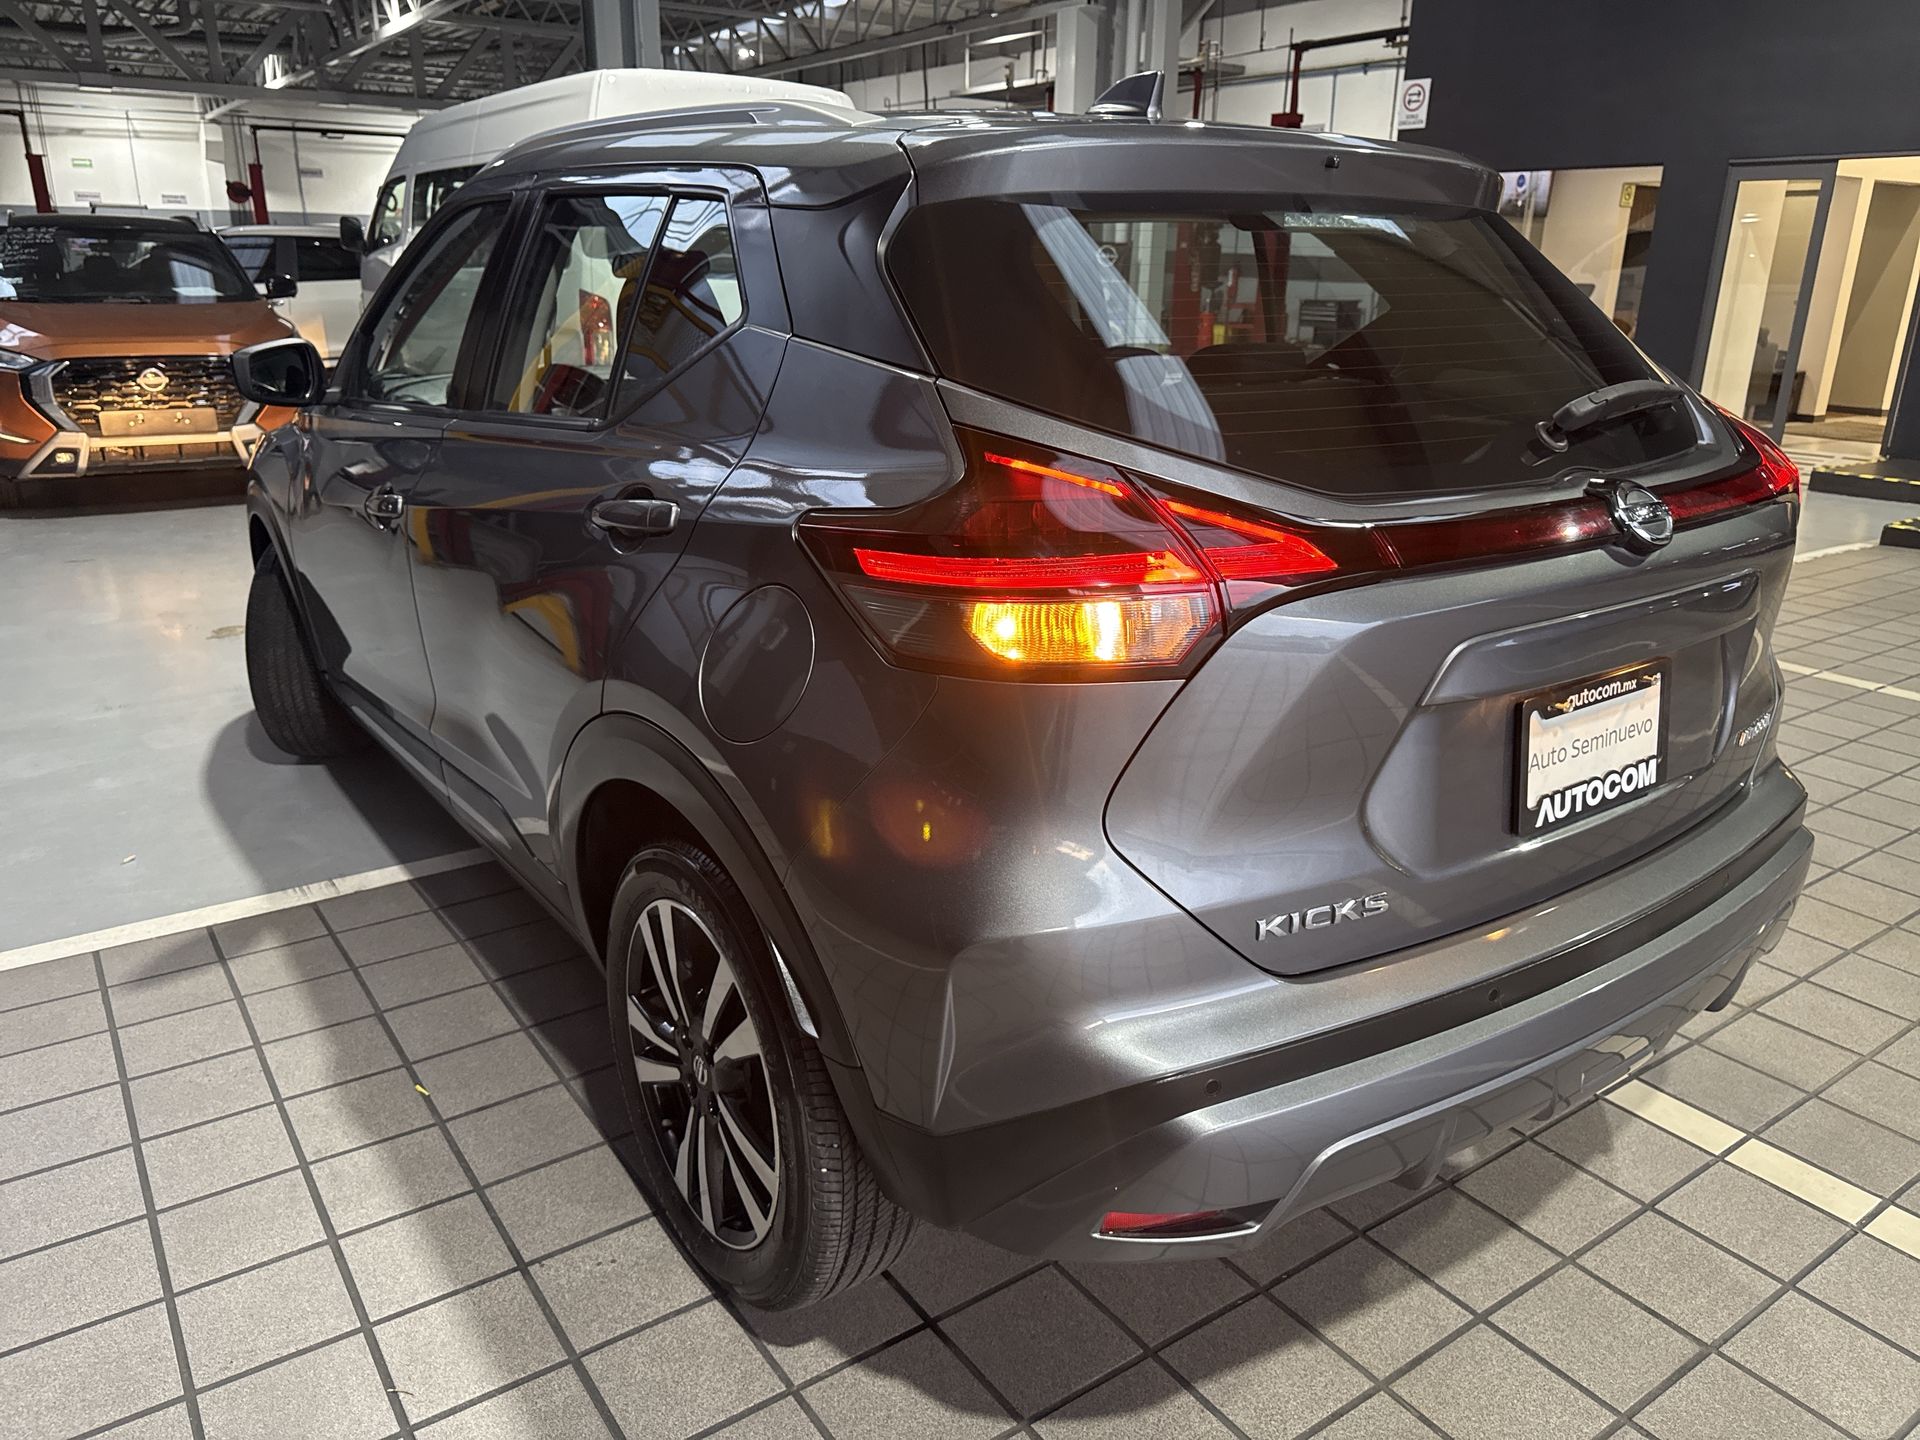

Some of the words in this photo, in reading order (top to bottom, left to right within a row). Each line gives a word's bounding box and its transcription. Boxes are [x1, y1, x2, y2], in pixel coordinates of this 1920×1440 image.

[1529, 747, 1567, 773] Auto
[1571, 718, 1653, 758] Seminuevo
[1535, 758, 1657, 828] AUTOCOM
[1255, 891, 1389, 942] KICKS
